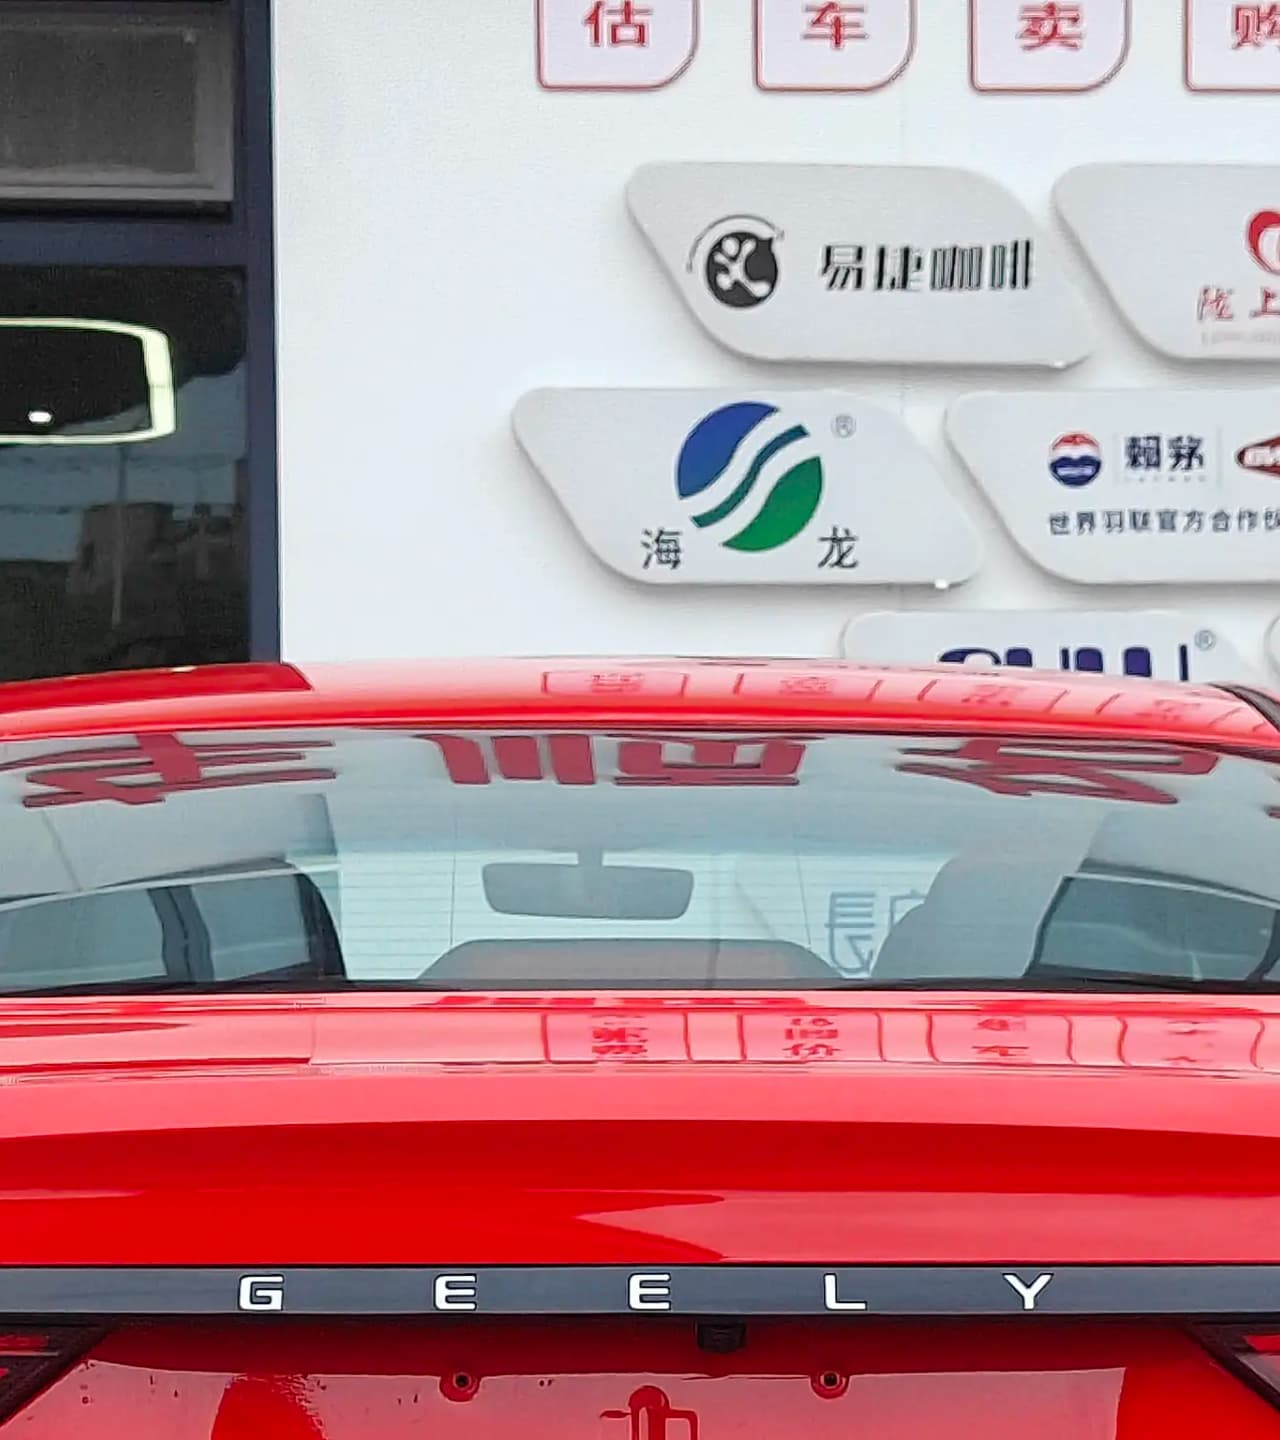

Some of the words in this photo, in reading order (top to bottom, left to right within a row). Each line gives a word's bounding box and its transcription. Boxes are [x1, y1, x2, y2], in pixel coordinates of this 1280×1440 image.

[585, 2, 650, 48] 估
[802, 2, 867, 49] 车
[1019, 3, 1082, 50] 卖
[821, 239, 1032, 291] 易捷咖啡
[236, 1271, 1055, 1314] GEELY
